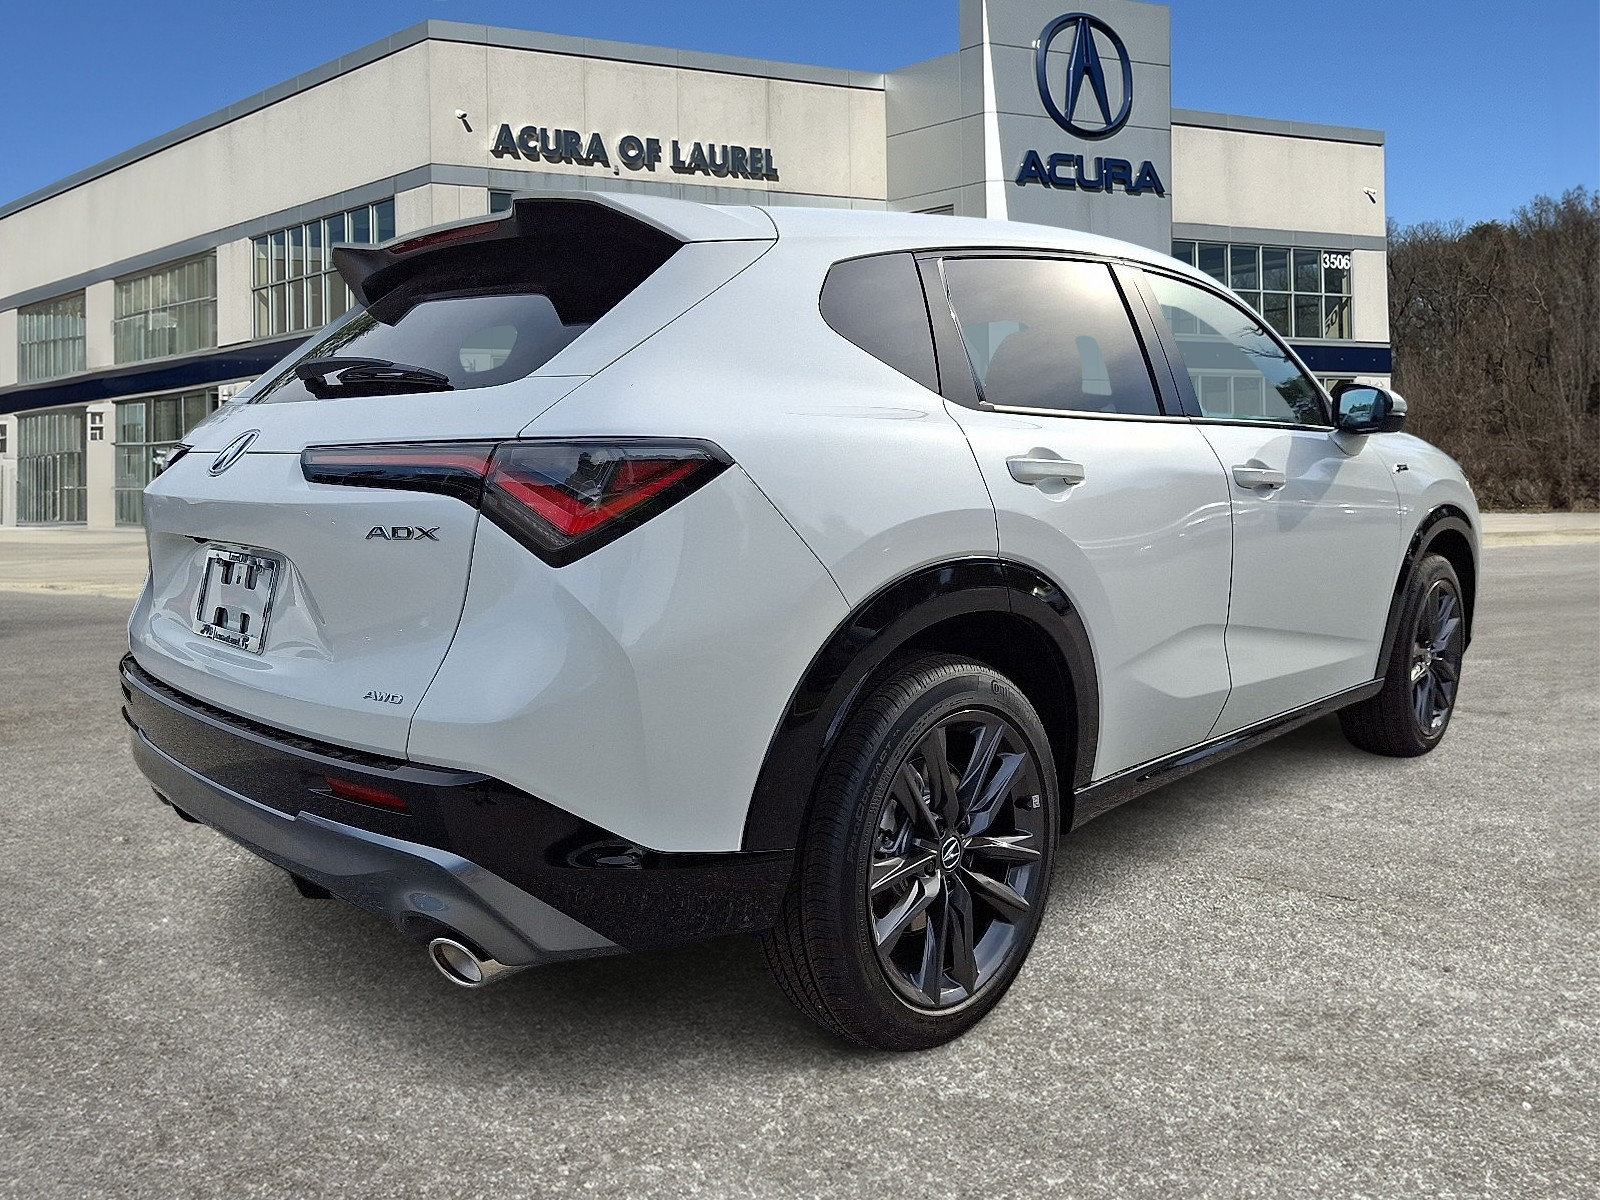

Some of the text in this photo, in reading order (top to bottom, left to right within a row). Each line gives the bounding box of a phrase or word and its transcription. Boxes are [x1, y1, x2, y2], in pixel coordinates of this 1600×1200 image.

[491, 123, 779, 181] ACURA OF LAUREL
[1016, 149, 1165, 197] ACURA
[1322, 253, 1350, 270] 3506
[364, 525, 441, 541] ADX
[362, 689, 404, 705] AWD
